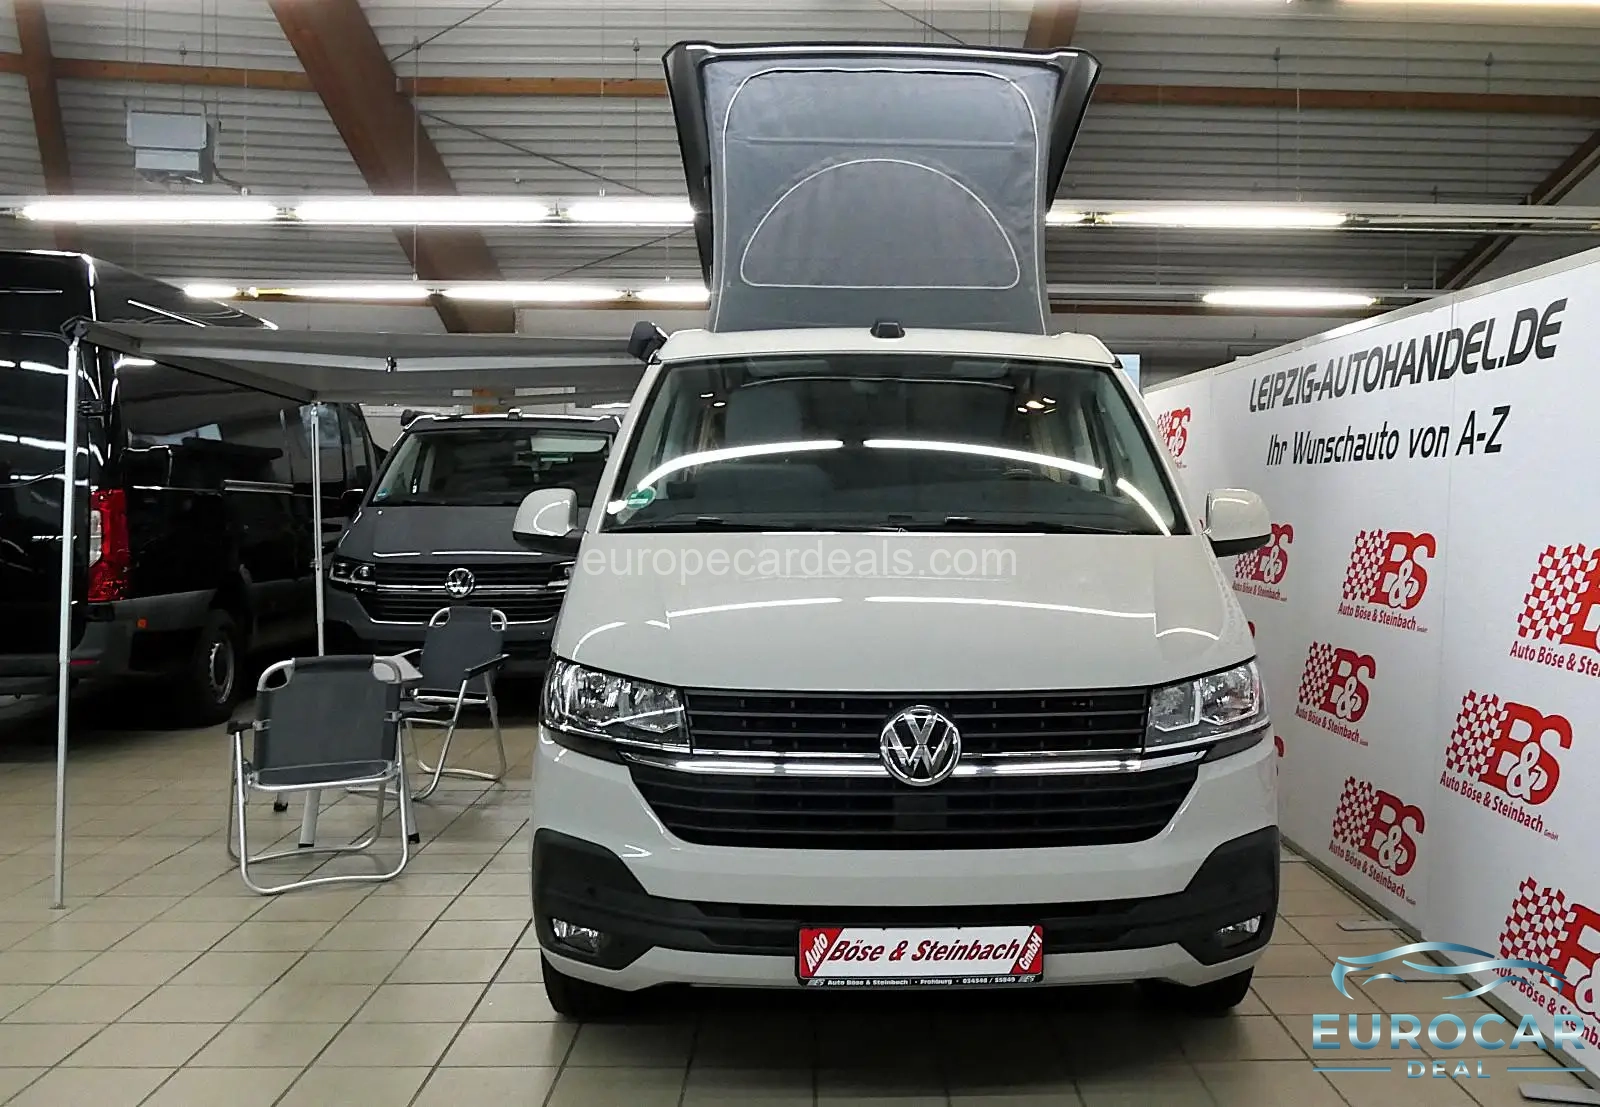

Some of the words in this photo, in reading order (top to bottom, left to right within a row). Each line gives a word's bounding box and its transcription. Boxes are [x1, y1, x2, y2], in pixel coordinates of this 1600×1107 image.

[1249, 298, 1568, 412] LEIPZIG-AUTOHANDEL.DE
[1266, 434, 1287, 466] Ihr
[1293, 421, 1399, 465] Wunschauto
[1409, 425, 1450, 459] von
[1455, 405, 1511, 457] A-Z
[1338, 602, 1354, 617] Auto
[1354, 605, 1371, 621] Böse
[1371, 609, 1378, 622] &
[1379, 610, 1417, 631] Steinbach
[1509, 640, 1536, 661] Auto
[1537, 646, 1564, 668] Böse
[1566, 652, 1576, 671] &
[1327, 719, 1360, 742] Steinbach
[1439, 771, 1460, 791] Auto
[1460, 781, 1482, 803] Böse
[1483, 792, 1491, 808] &
[1492, 796, 1543, 833] Steinbach
[1328, 840, 1344, 858] Auto
[1362, 861, 1368, 873] &
[1368, 864, 1406, 899] Steinbach
[803, 932, 829, 973] Auto
[827, 939, 885, 962] Böse
[888, 940, 909, 961] &
[911, 938, 1021, 962] Steinbach
[1018, 932, 1044, 971] GmbH
[872, 978, 908, 986] Steinbach
[1547, 997, 1557, 1015] &
